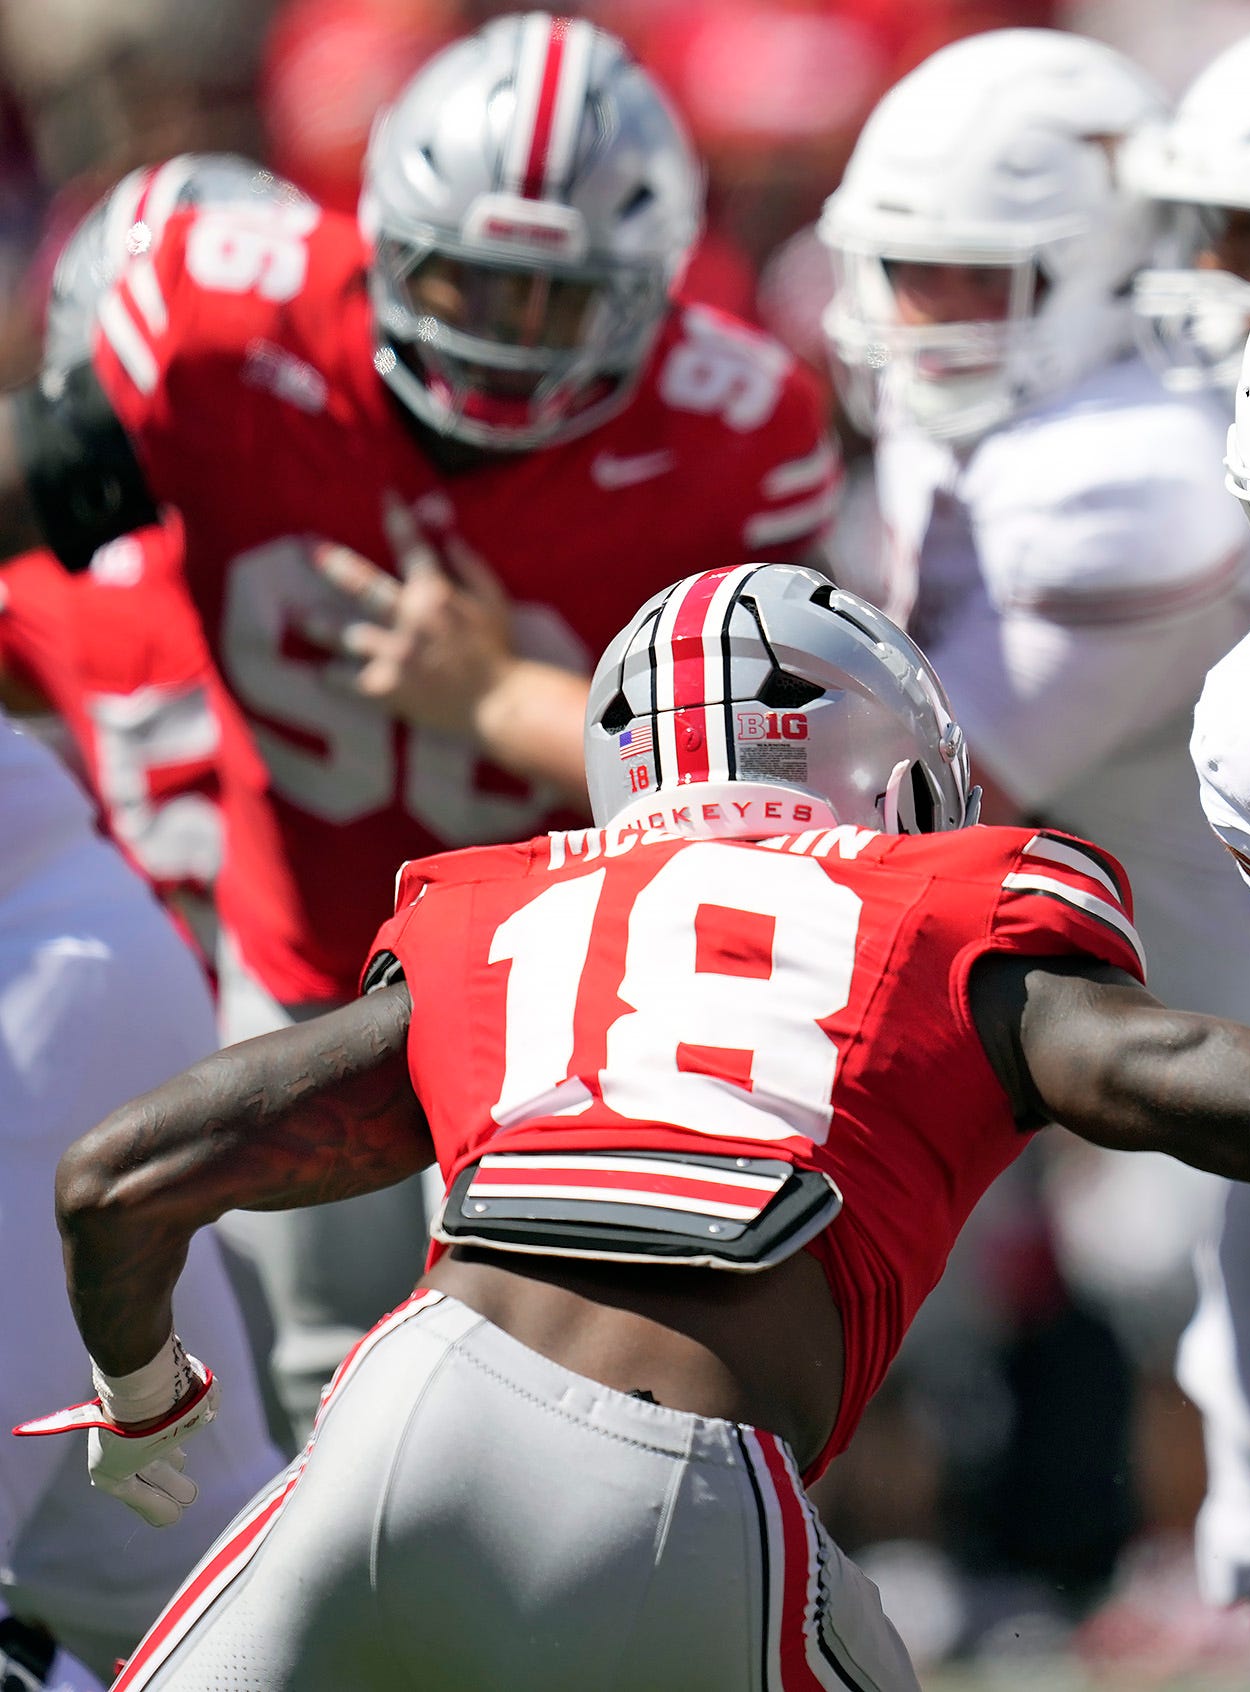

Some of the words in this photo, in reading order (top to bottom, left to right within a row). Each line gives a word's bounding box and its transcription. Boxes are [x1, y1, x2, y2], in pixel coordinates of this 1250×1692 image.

[629, 764, 649, 793] 18
[628, 801, 812, 830] CKEYES
[488, 841, 864, 1146] 18
